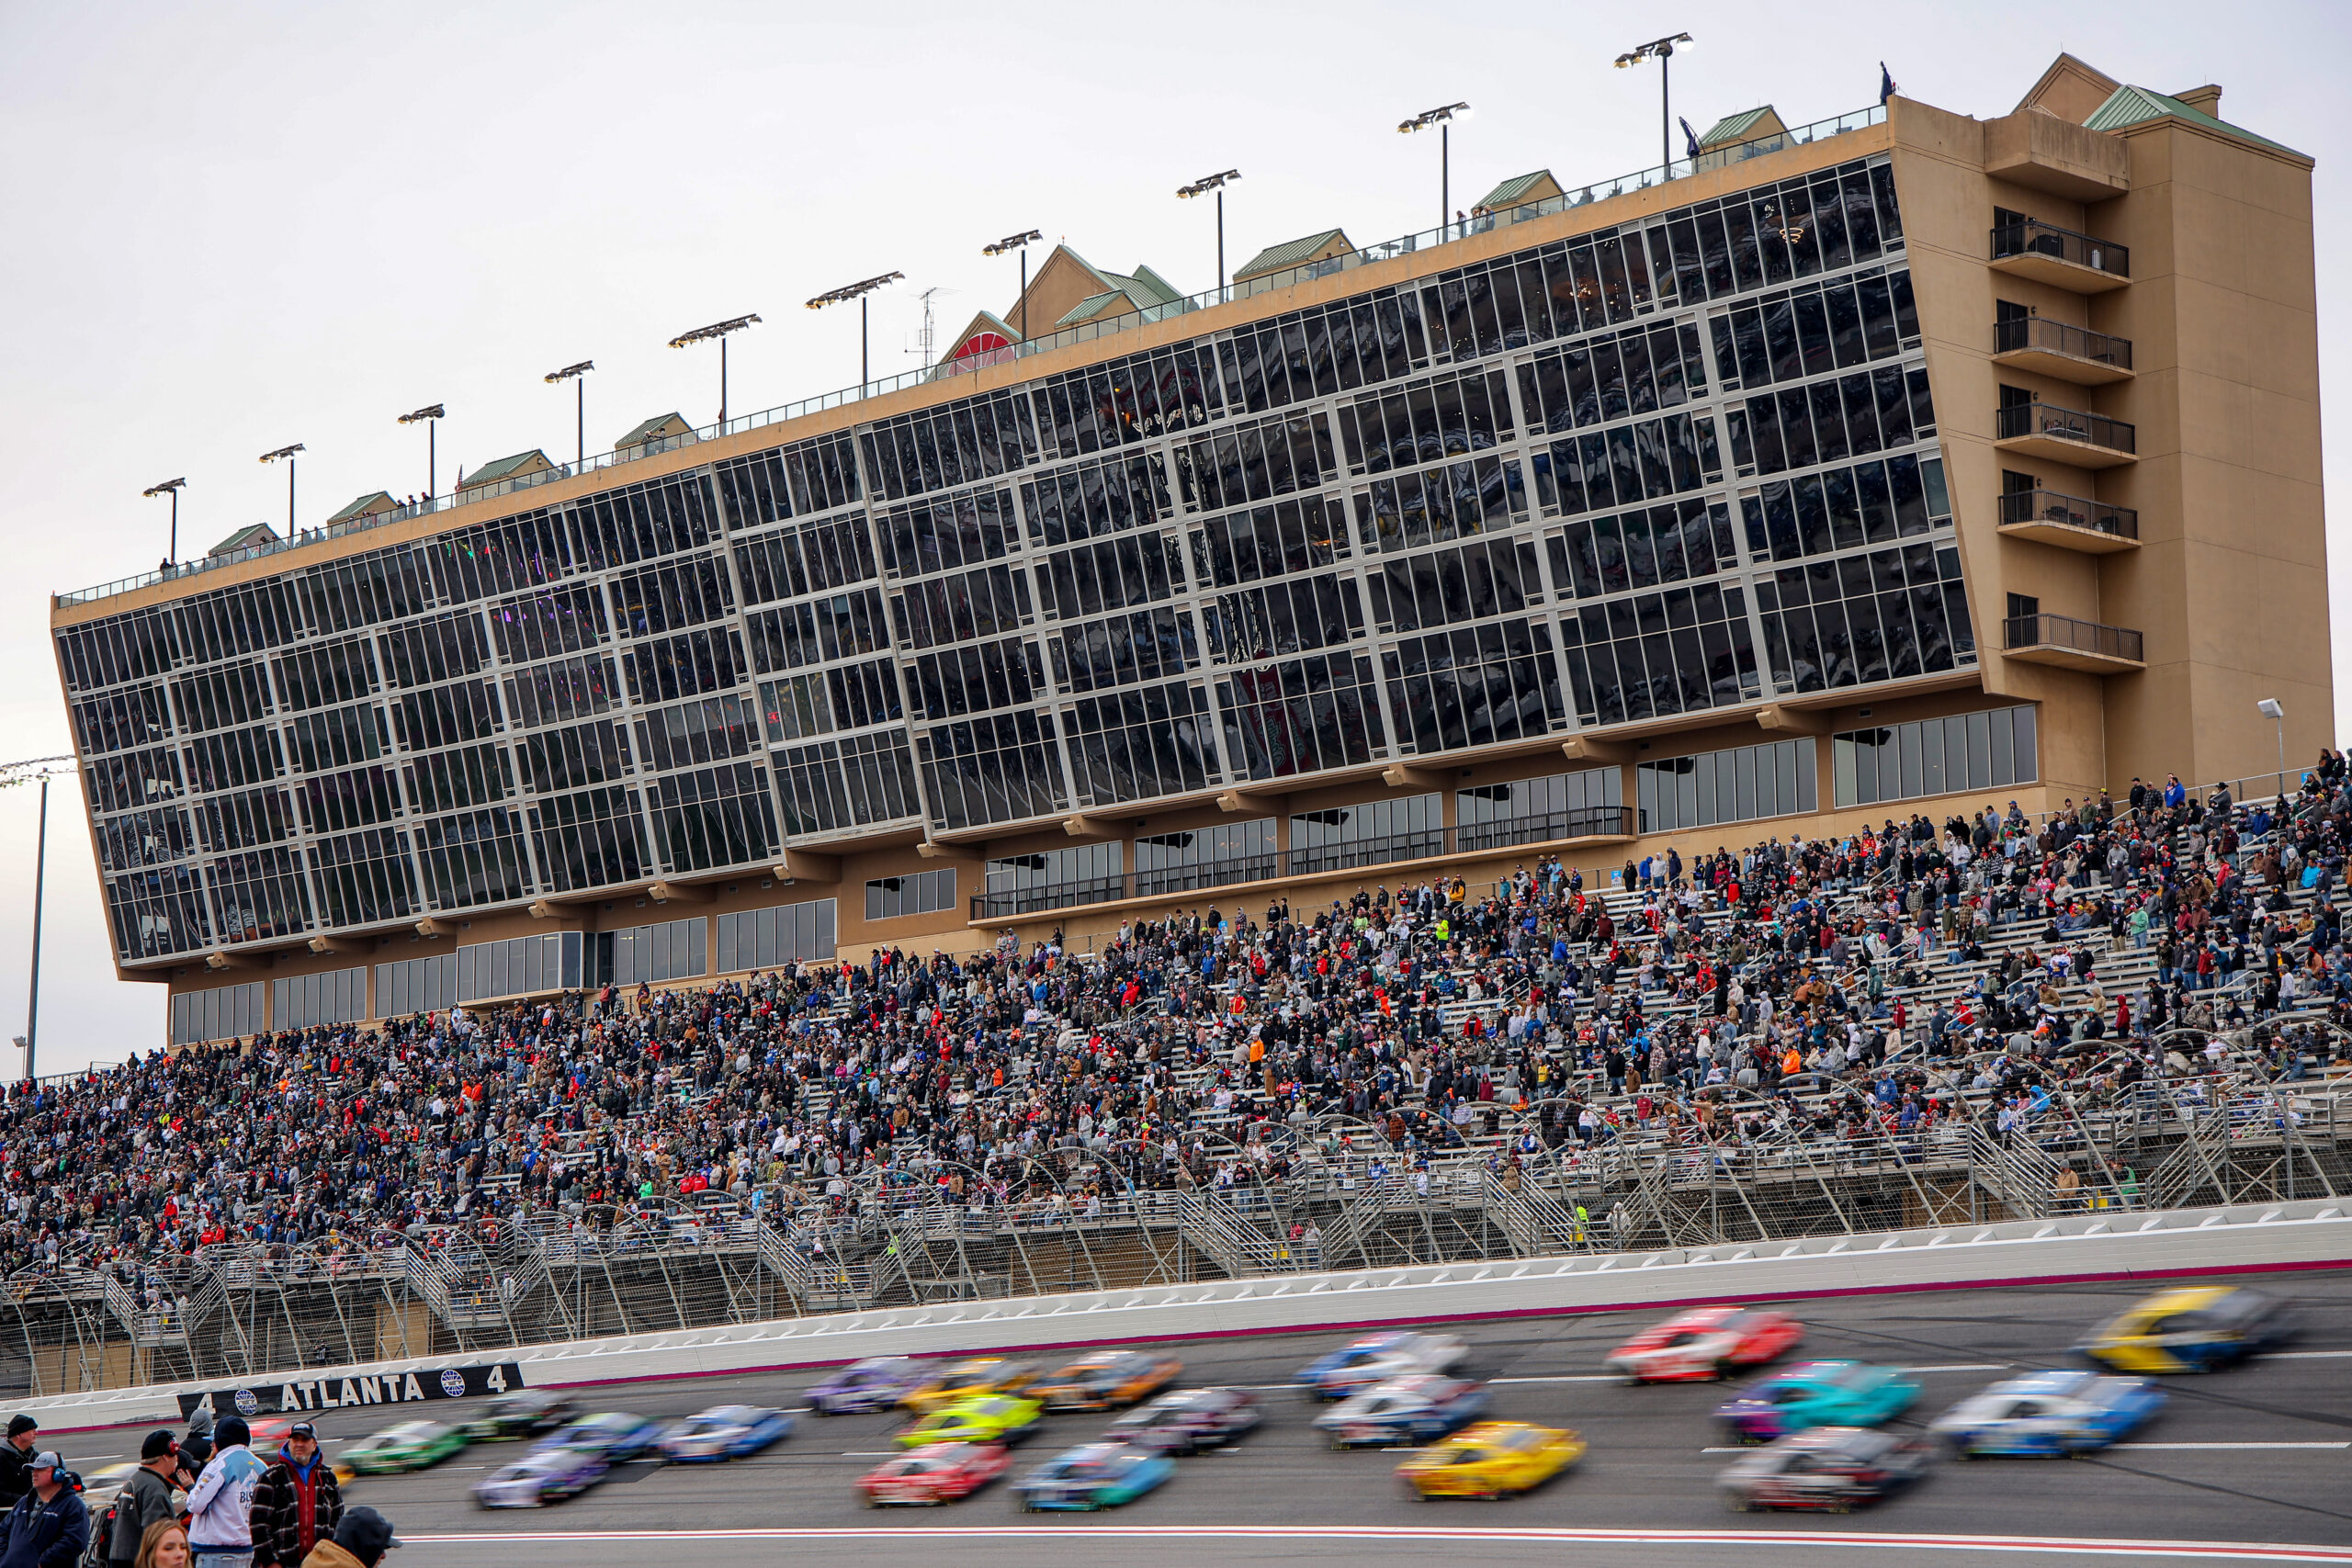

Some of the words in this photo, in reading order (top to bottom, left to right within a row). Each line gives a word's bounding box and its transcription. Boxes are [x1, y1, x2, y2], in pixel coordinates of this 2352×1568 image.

[197, 1393, 217, 1416] 4
[280, 1372, 425, 1412] ATLANTA
[486, 1365, 507, 1393] 4
